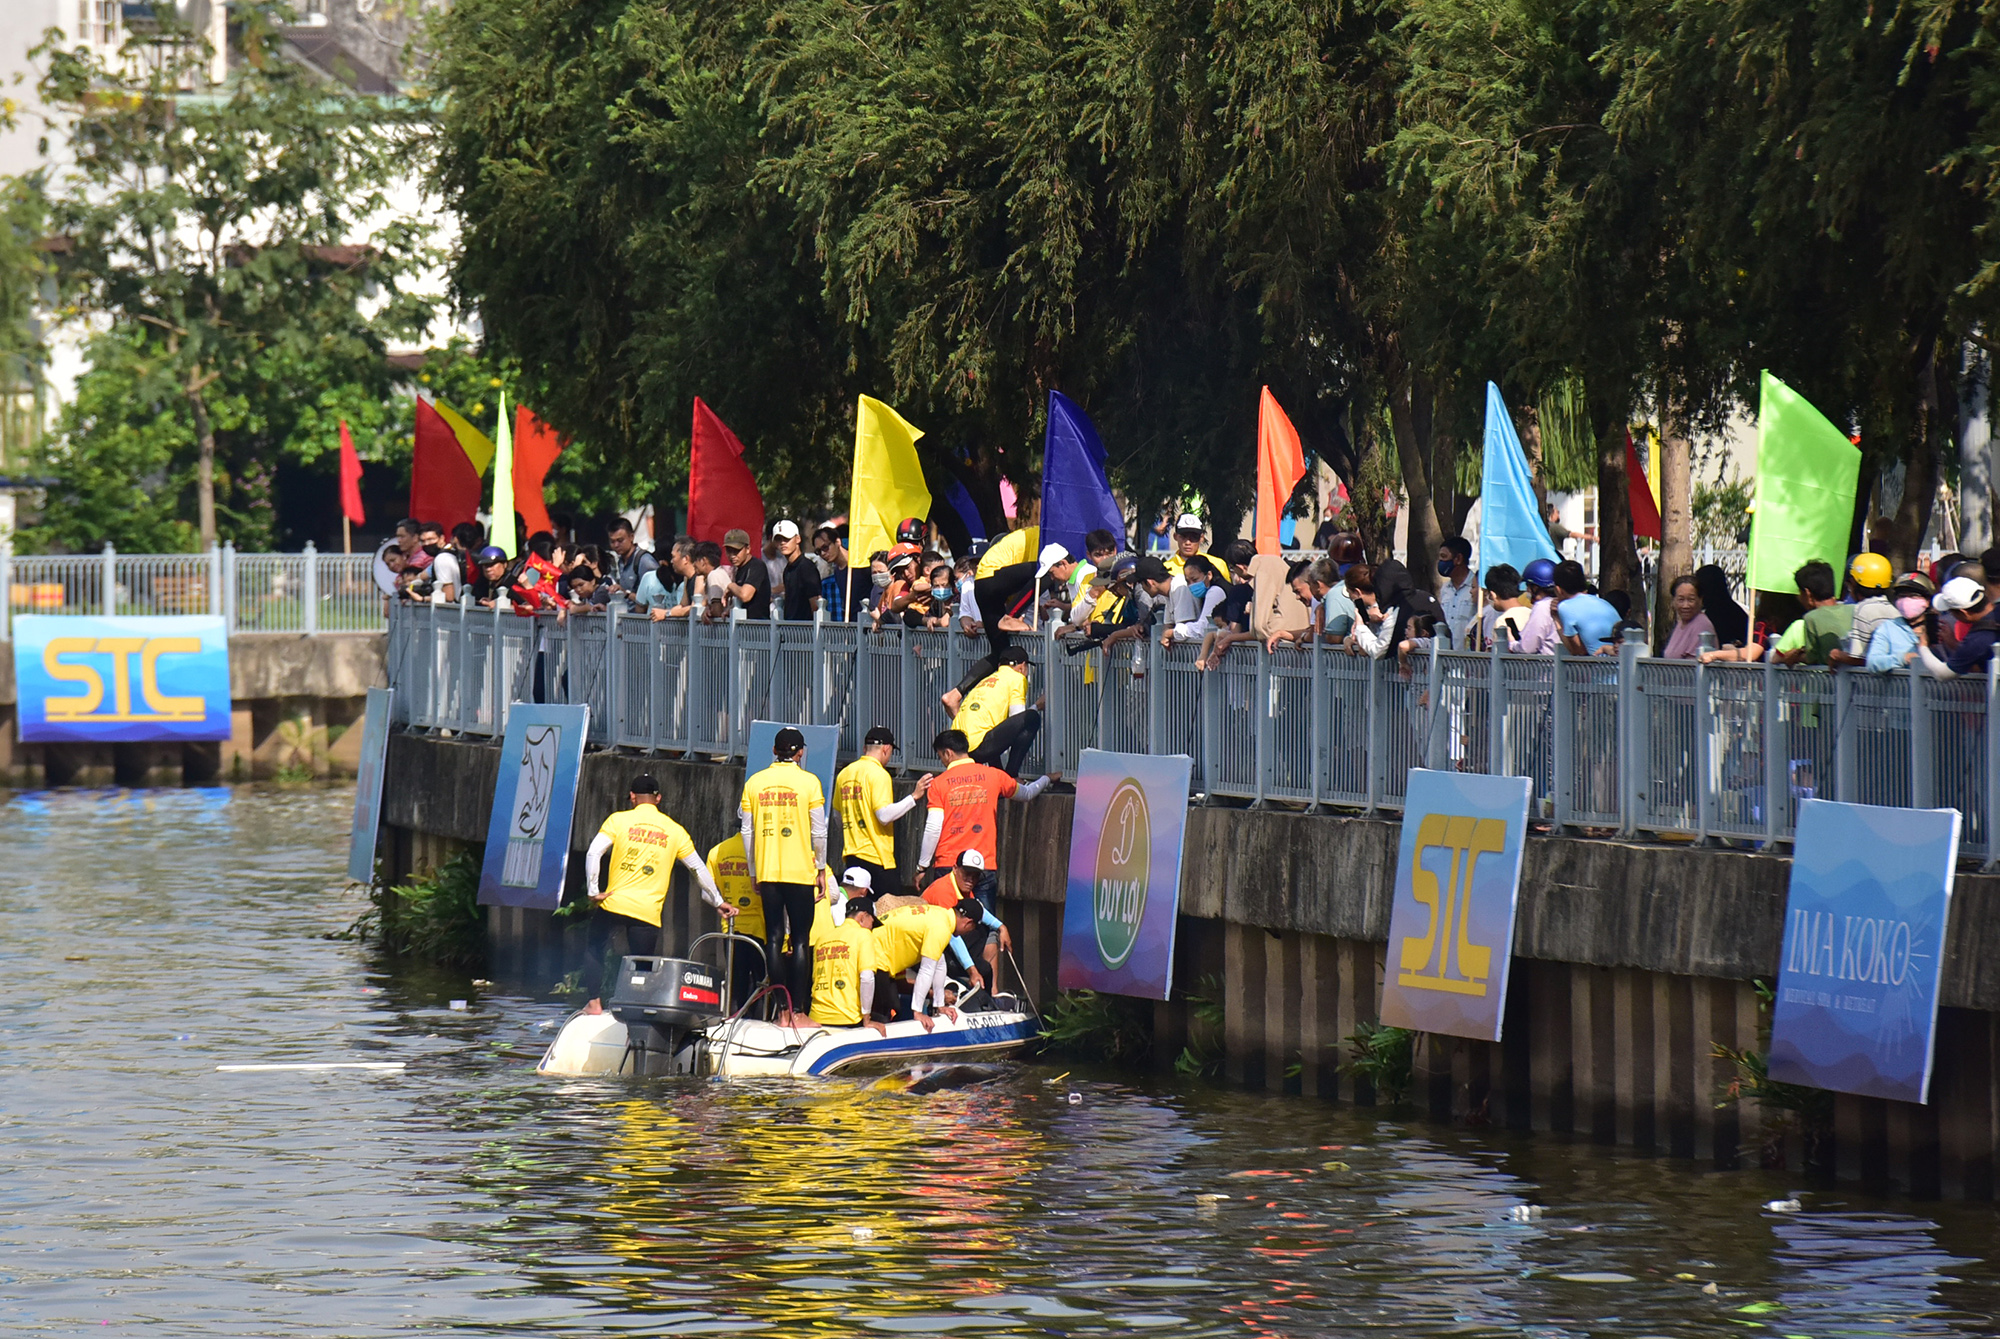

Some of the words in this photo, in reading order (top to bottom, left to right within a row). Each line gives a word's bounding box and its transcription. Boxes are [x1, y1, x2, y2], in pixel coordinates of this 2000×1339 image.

[43, 636, 206, 718] STC
[620, 861, 637, 873] STC
[1399, 813, 1507, 986] STC
[1099, 878, 1122, 923] DUY
[1122, 877, 1141, 937] LỢI
[692, 973, 713, 988] YAMAHA
[1787, 908, 1834, 977] IMA
[1838, 916, 1911, 986] KOKO
